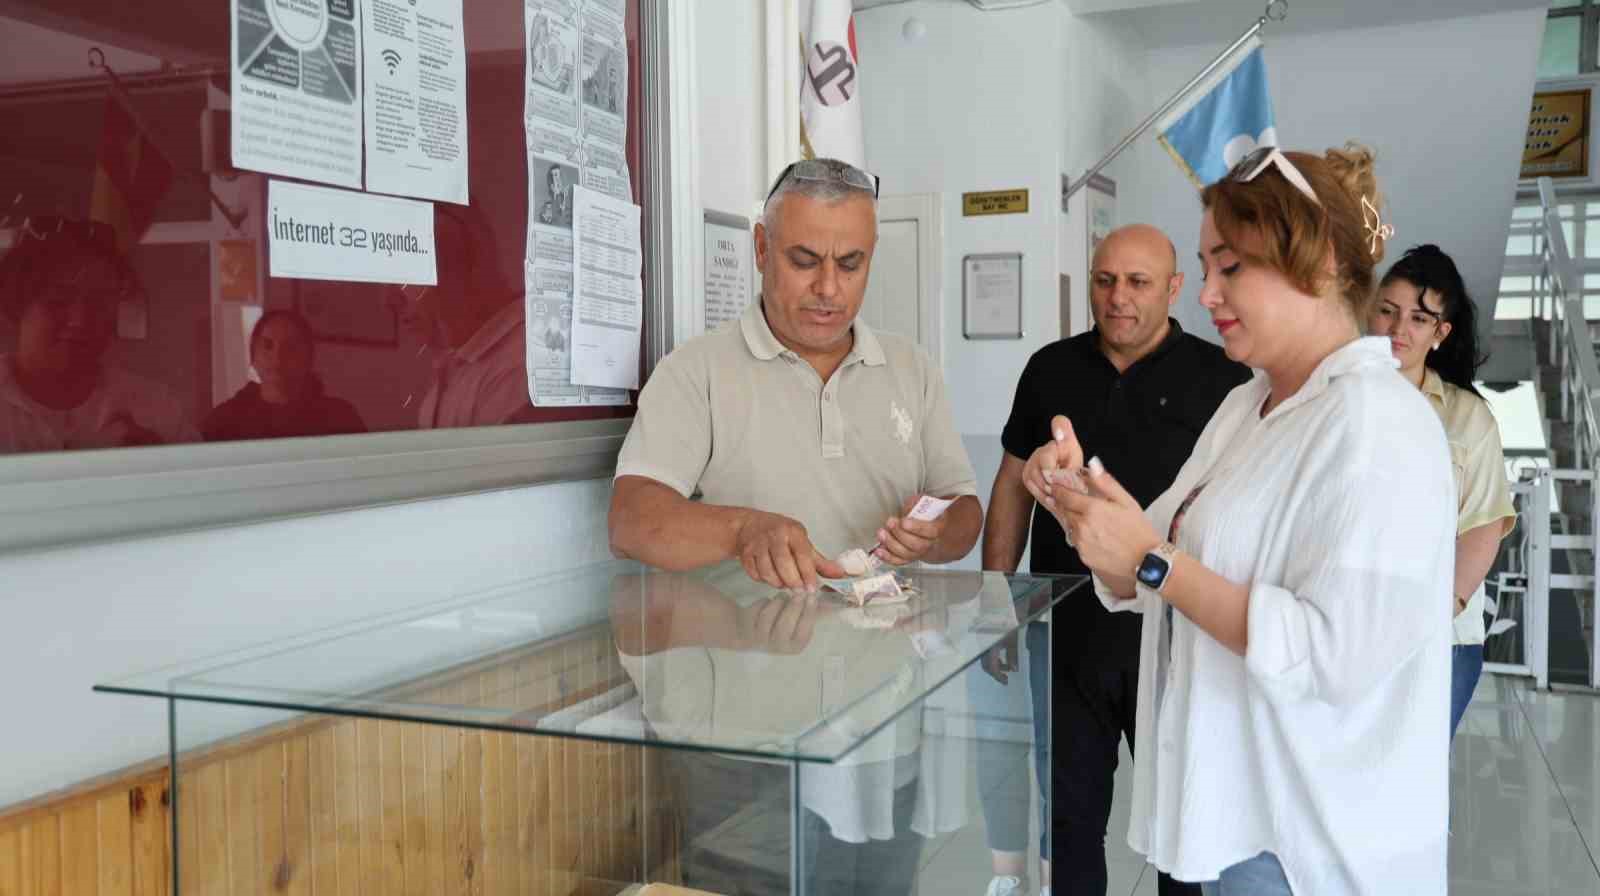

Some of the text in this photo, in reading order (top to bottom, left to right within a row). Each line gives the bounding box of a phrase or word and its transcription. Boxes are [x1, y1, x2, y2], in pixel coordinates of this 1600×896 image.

[273, 207, 428, 256] İnternet 32 yaşında...
